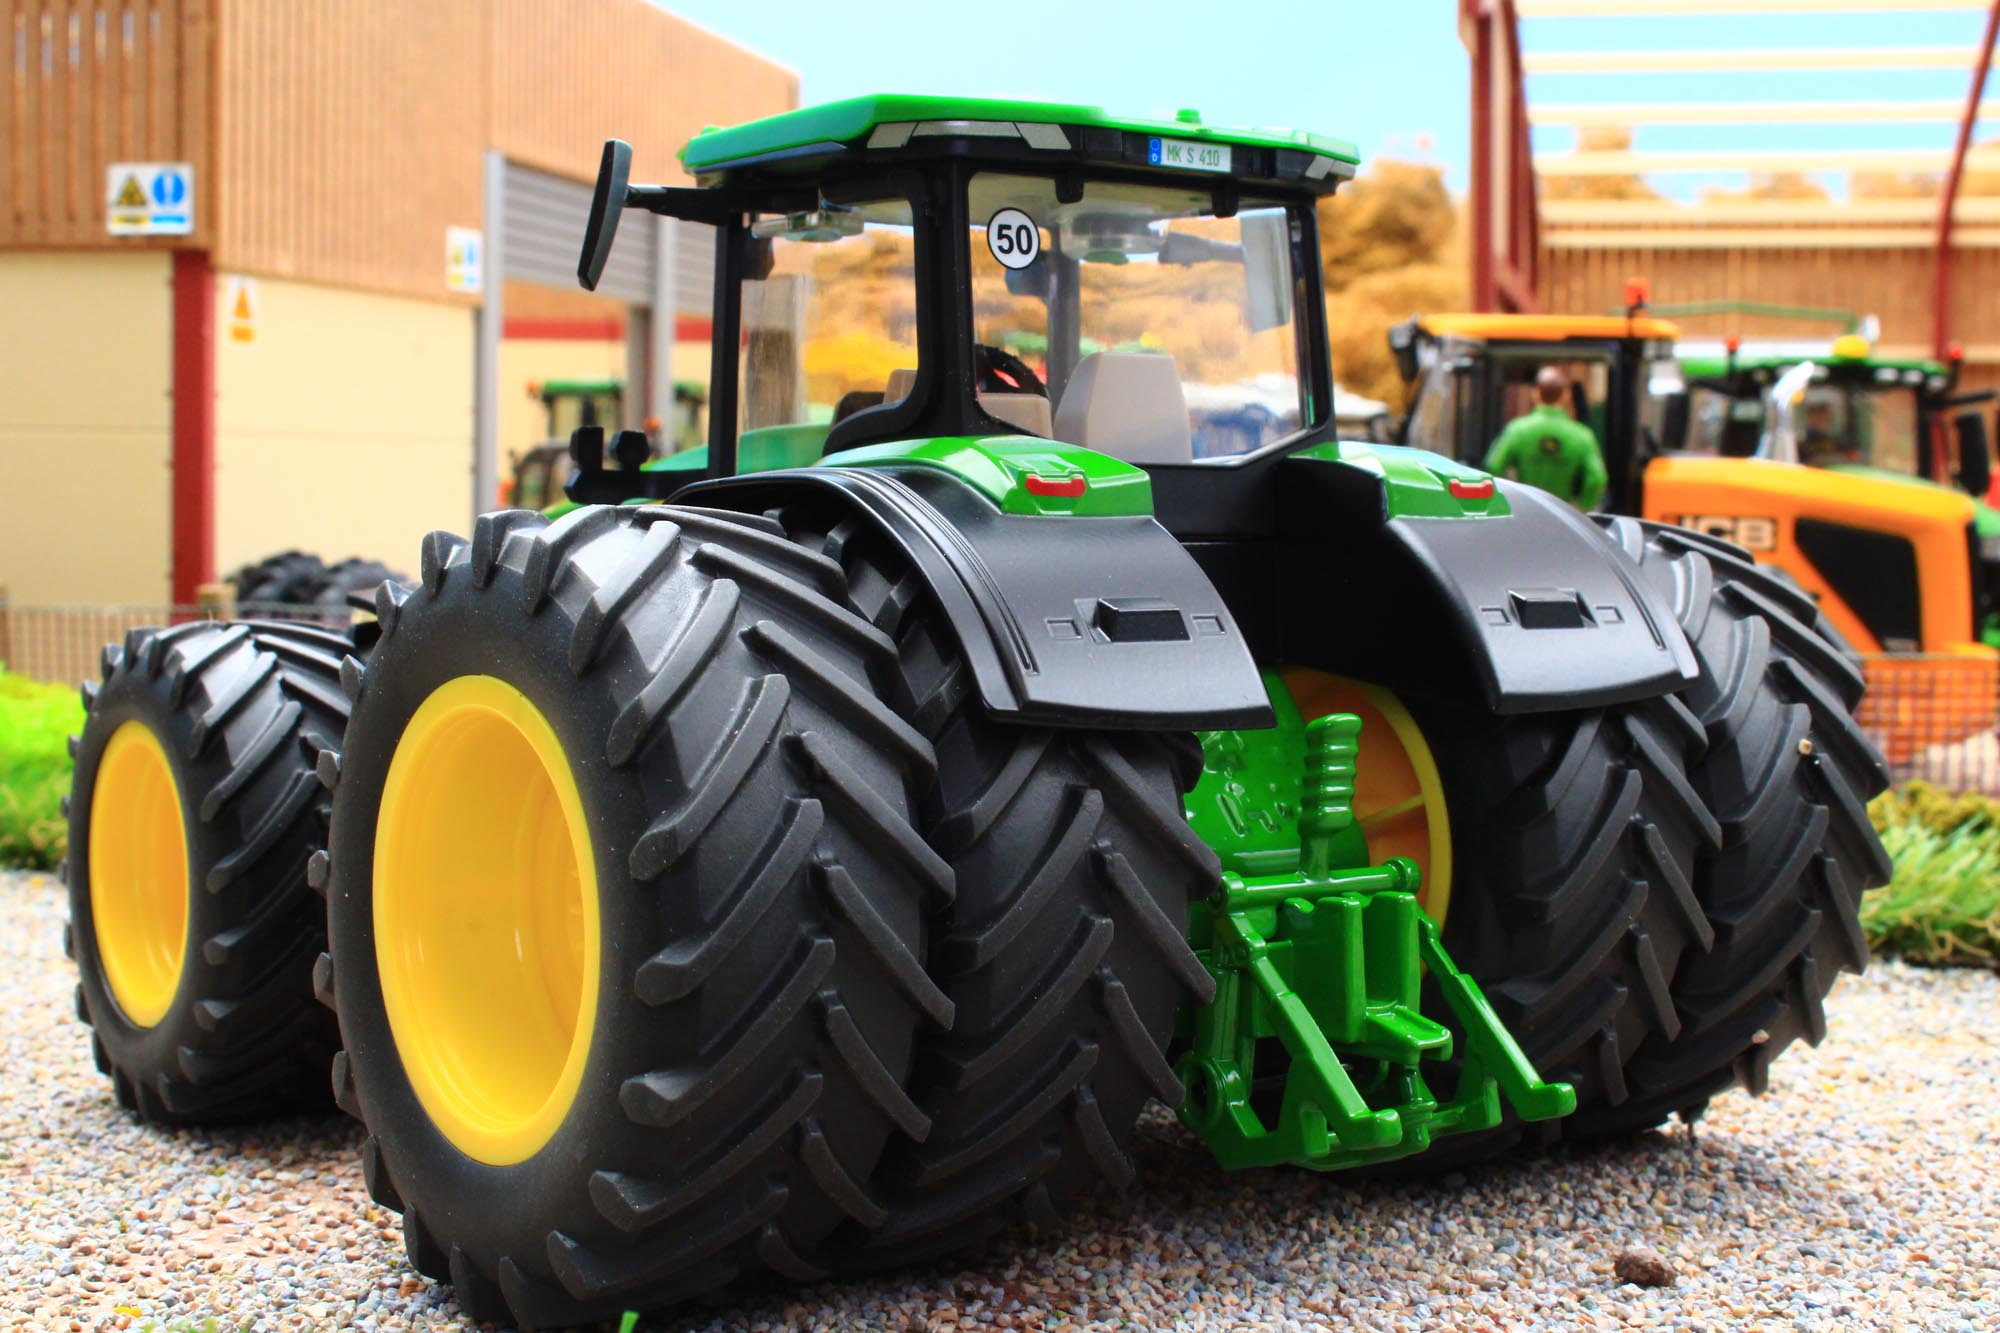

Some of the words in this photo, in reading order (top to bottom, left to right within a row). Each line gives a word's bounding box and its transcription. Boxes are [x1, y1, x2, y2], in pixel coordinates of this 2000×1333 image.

[1167, 144, 1181, 162] MK
[1186, 147, 1194, 164] S
[1199, 149, 1220, 167] 410
[997, 224, 1033, 255] 50
